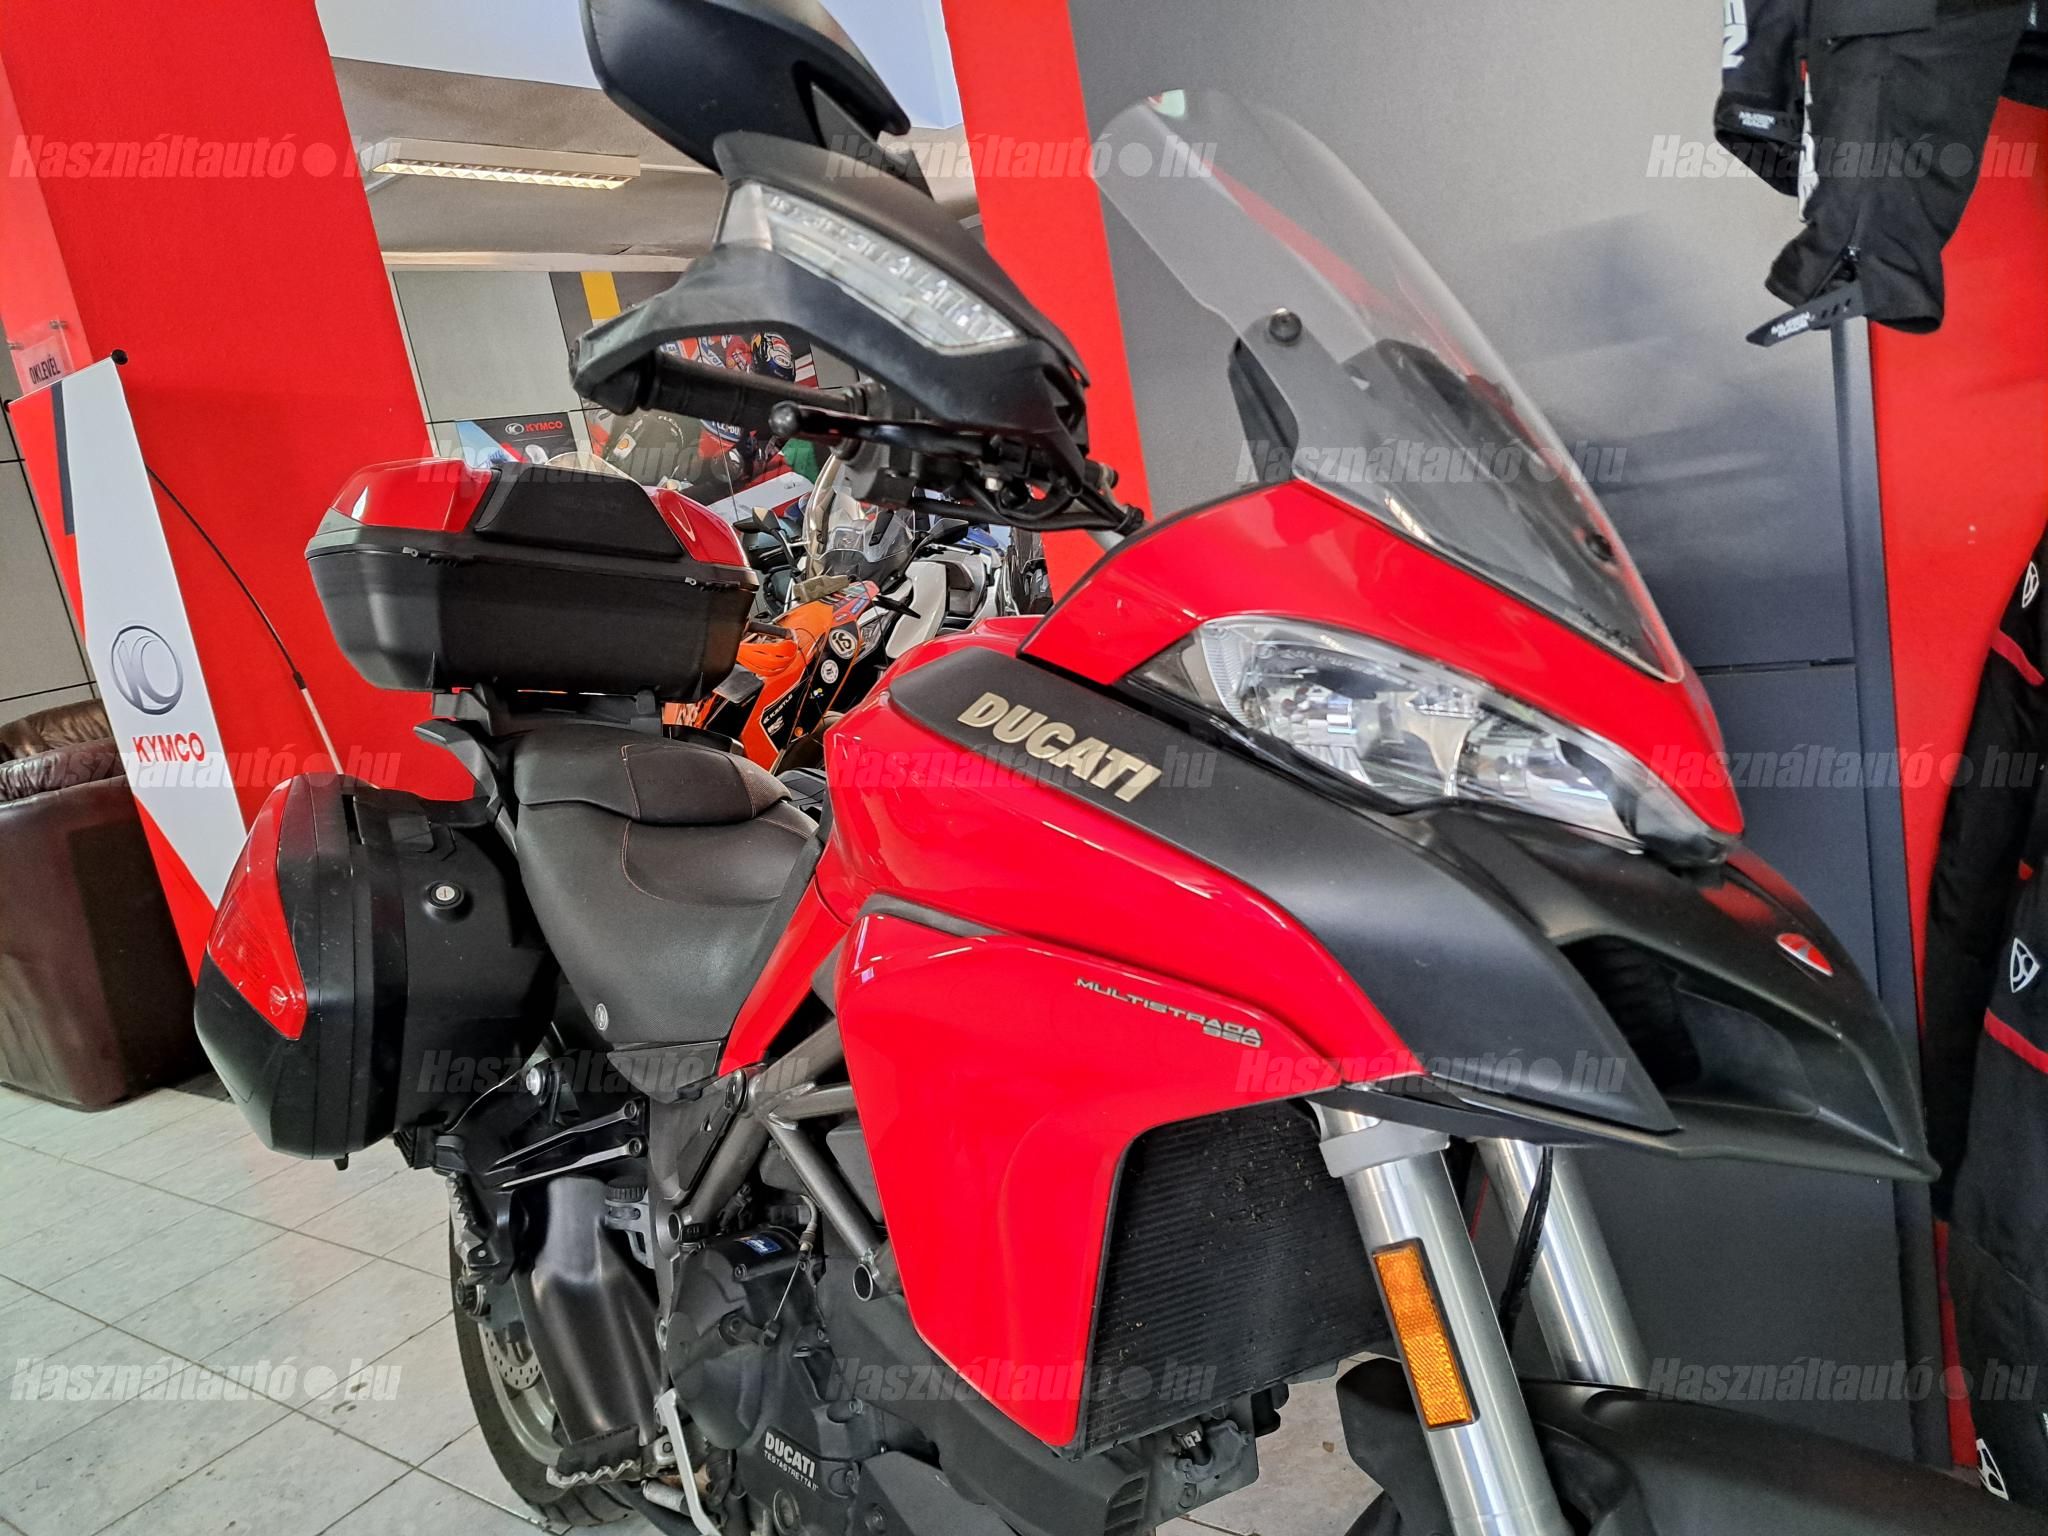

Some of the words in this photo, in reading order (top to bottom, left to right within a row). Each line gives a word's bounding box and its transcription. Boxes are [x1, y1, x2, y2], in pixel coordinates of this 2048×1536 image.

[29, 353, 61, 385] OKLEVÉL
[525, 420, 564, 433] KYMCO
[132, 731, 206, 764] KYMCO
[956, 691, 1163, 803] DUCATI
[1075, 976, 1263, 1039] MULTISTRADA
[1202, 1025, 1263, 1048] 950
[764, 1431, 816, 1480] DUCATI
